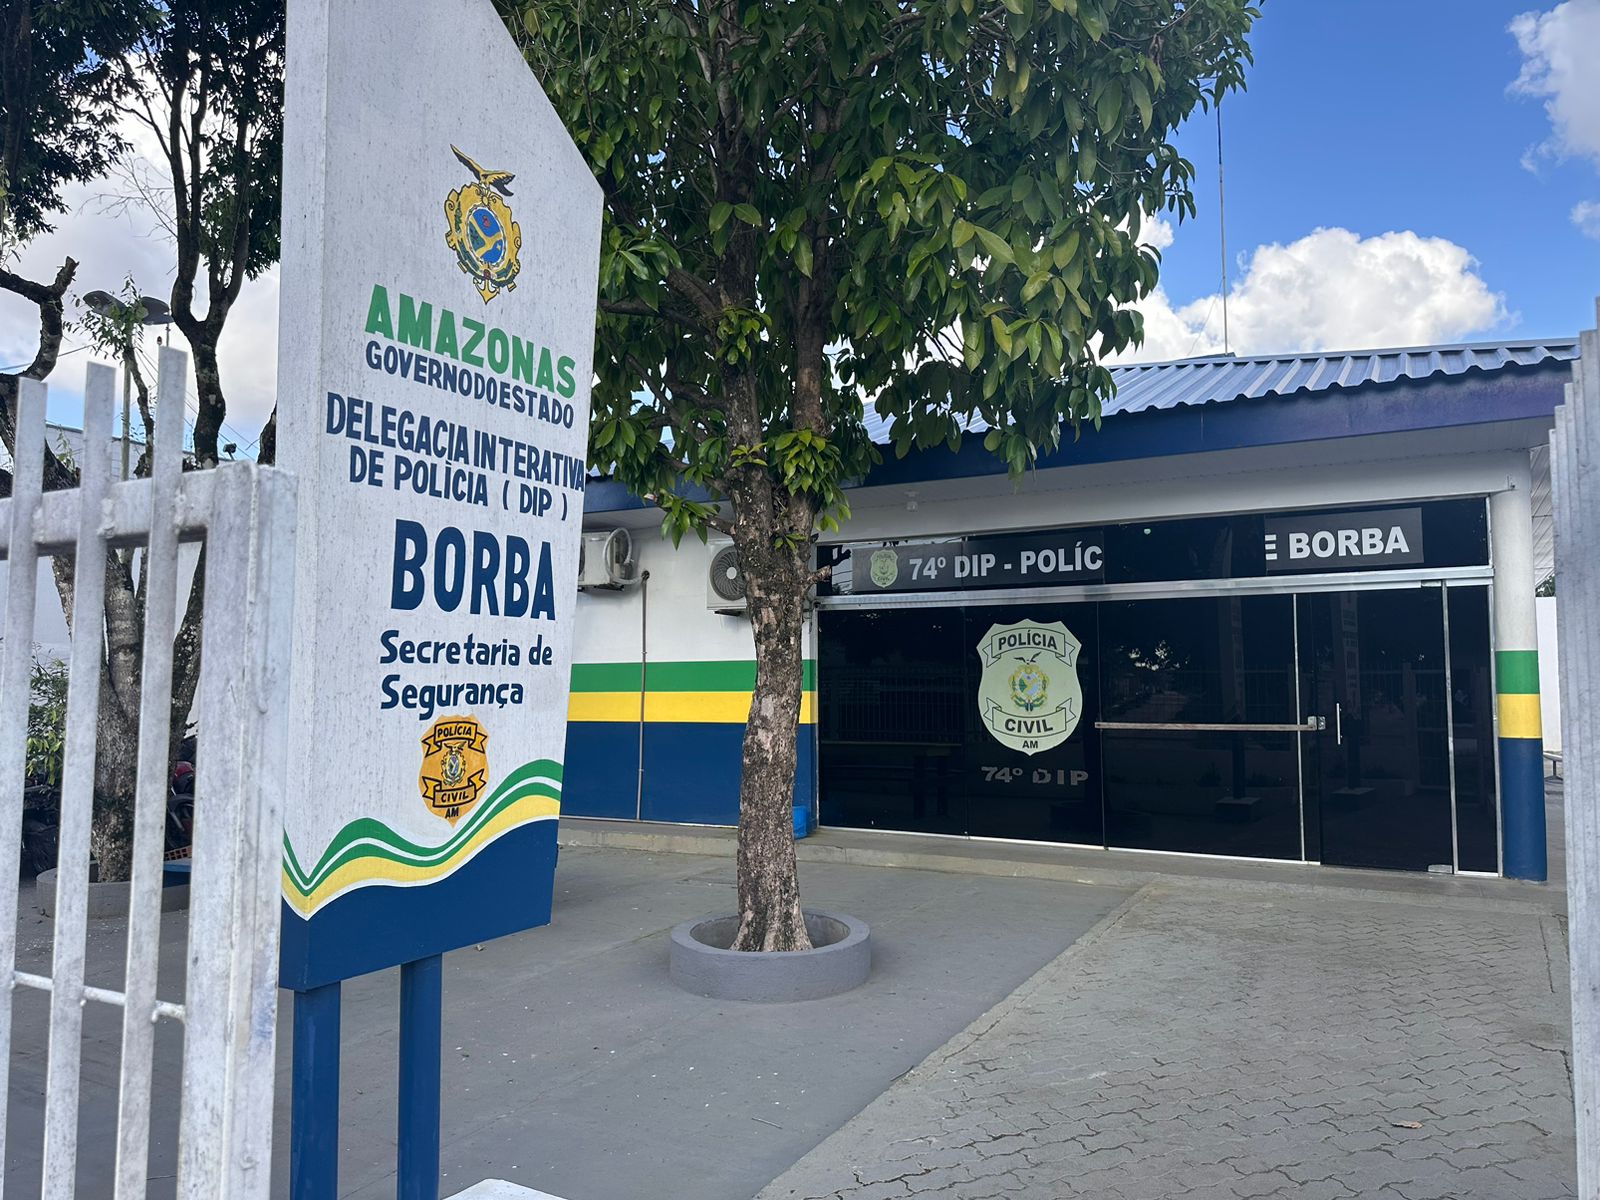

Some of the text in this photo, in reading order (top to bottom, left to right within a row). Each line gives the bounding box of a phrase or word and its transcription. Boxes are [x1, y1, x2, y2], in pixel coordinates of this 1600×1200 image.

[364, 283, 577, 399] AMAZONAS
[326, 391, 585, 492] DELEGACIA INTERATIVA
[349, 445, 384, 487] DE
[954, 553, 996, 579] DIP
[1289, 526, 1410, 559] BORBA
[390, 518, 556, 621] BORBA
[380, 629, 553, 666] Secretaria de
[998, 630, 1058, 651] POLÍCIA
[380, 674, 524, 721] Segurança
[437, 723, 472, 738] POLÍCIA
[1004, 718, 1054, 734] CIVIL
[1022, 740, 1039, 749] AM
[1032, 768, 1089, 786] DIP
[441, 792, 469, 803] CIVIL
[445, 807, 460, 819] AM
